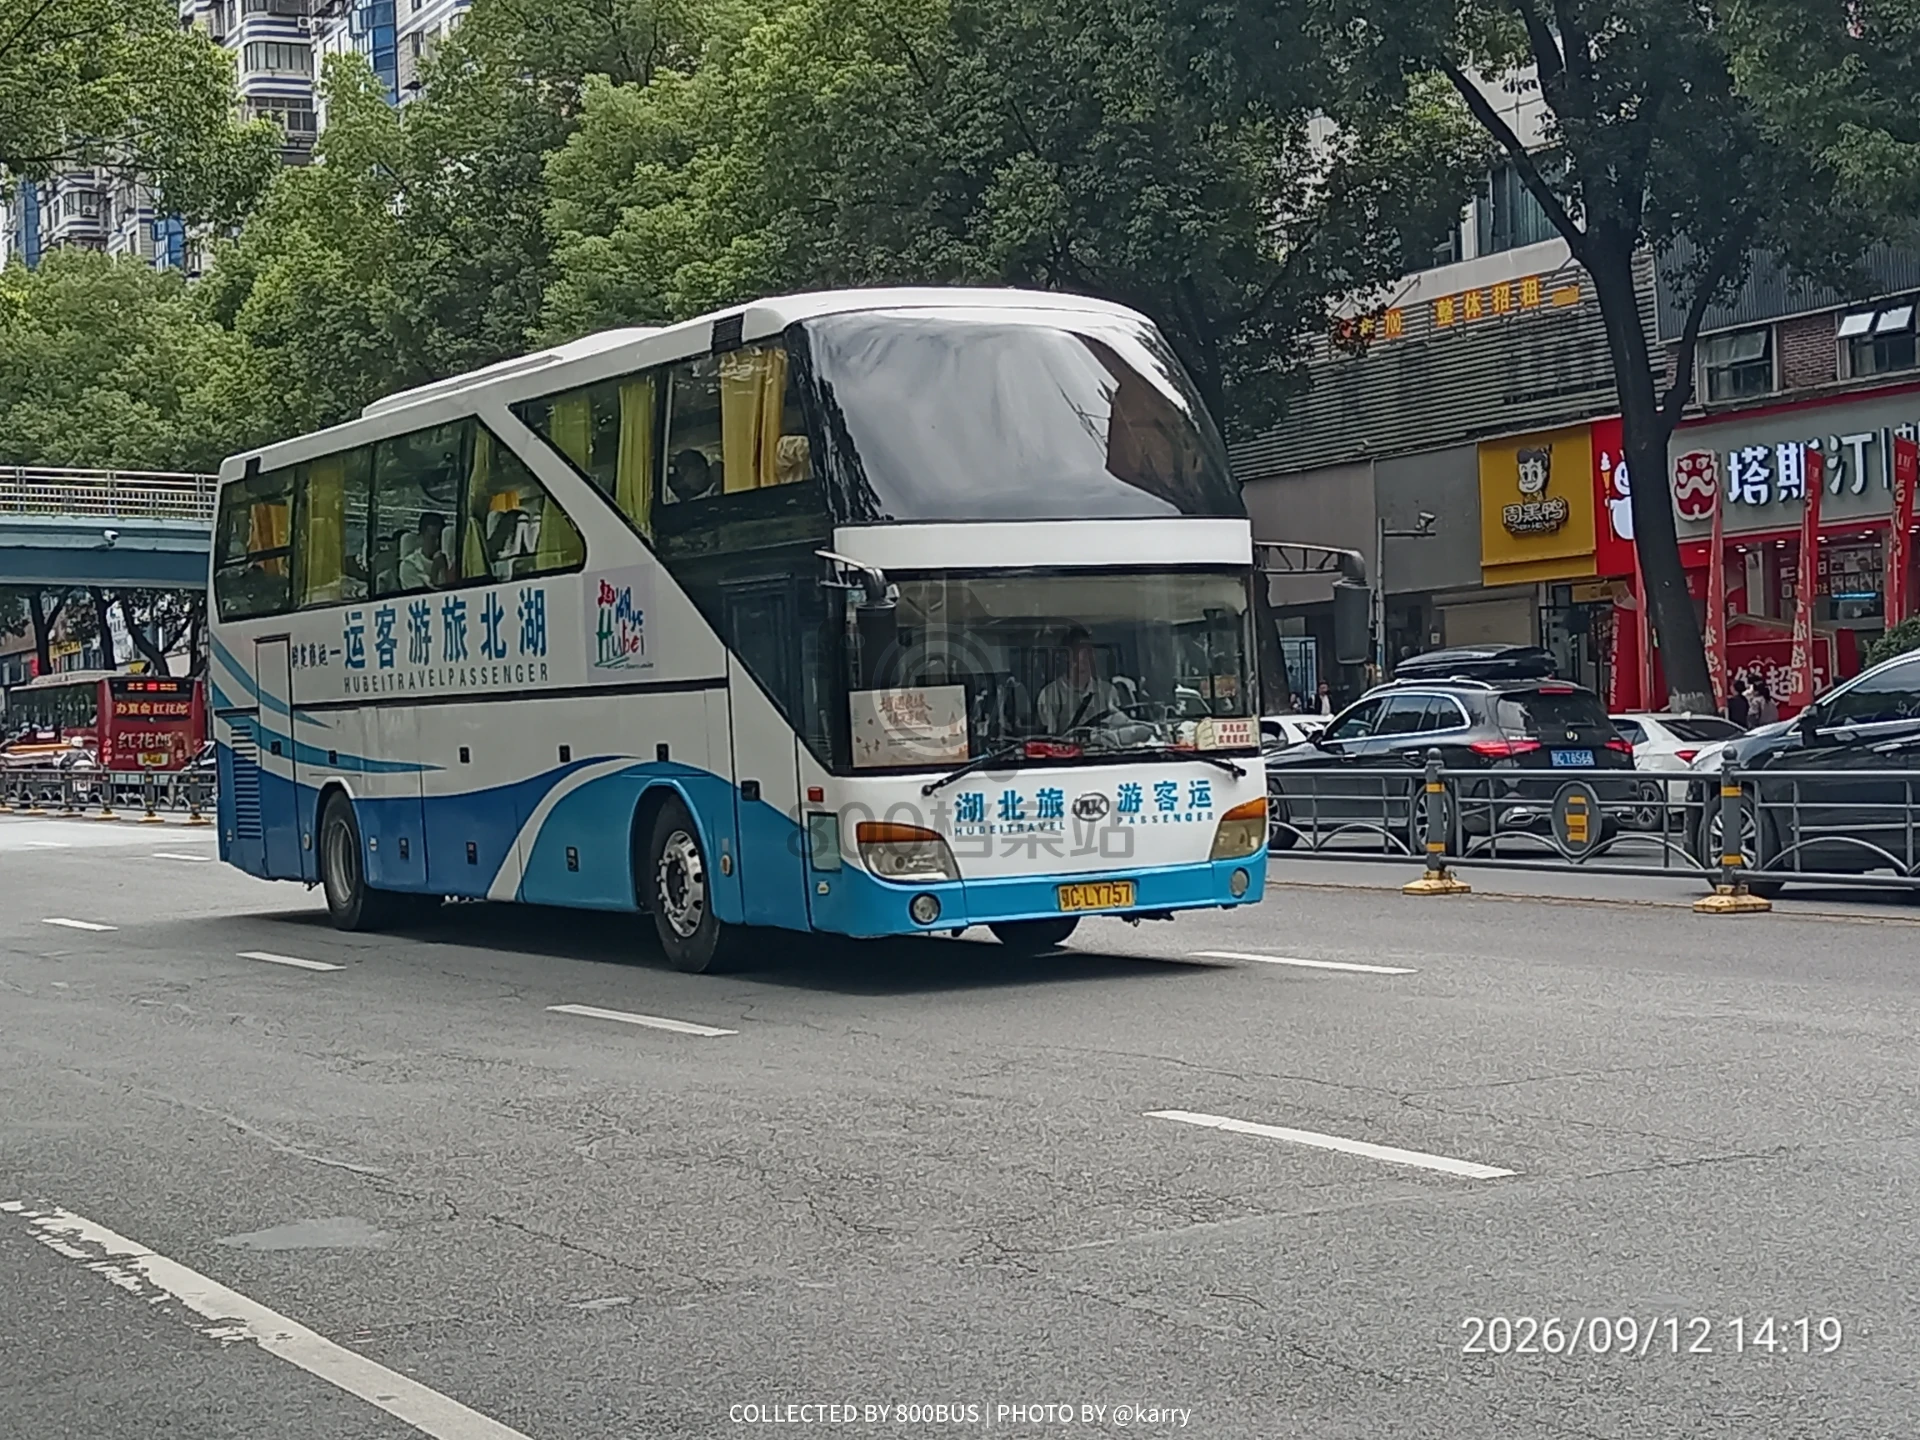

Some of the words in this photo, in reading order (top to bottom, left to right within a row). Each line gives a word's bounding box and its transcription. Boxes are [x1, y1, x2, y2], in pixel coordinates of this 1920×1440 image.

[1437, 277, 1540, 326] 整体招租
[1503, 499, 1565, 524] 周黑鸭
[954, 786, 1066, 824] 湖北旅
[1116, 779, 1212, 815] 游客运
[1116, 811, 1214, 825] PASSENGER
